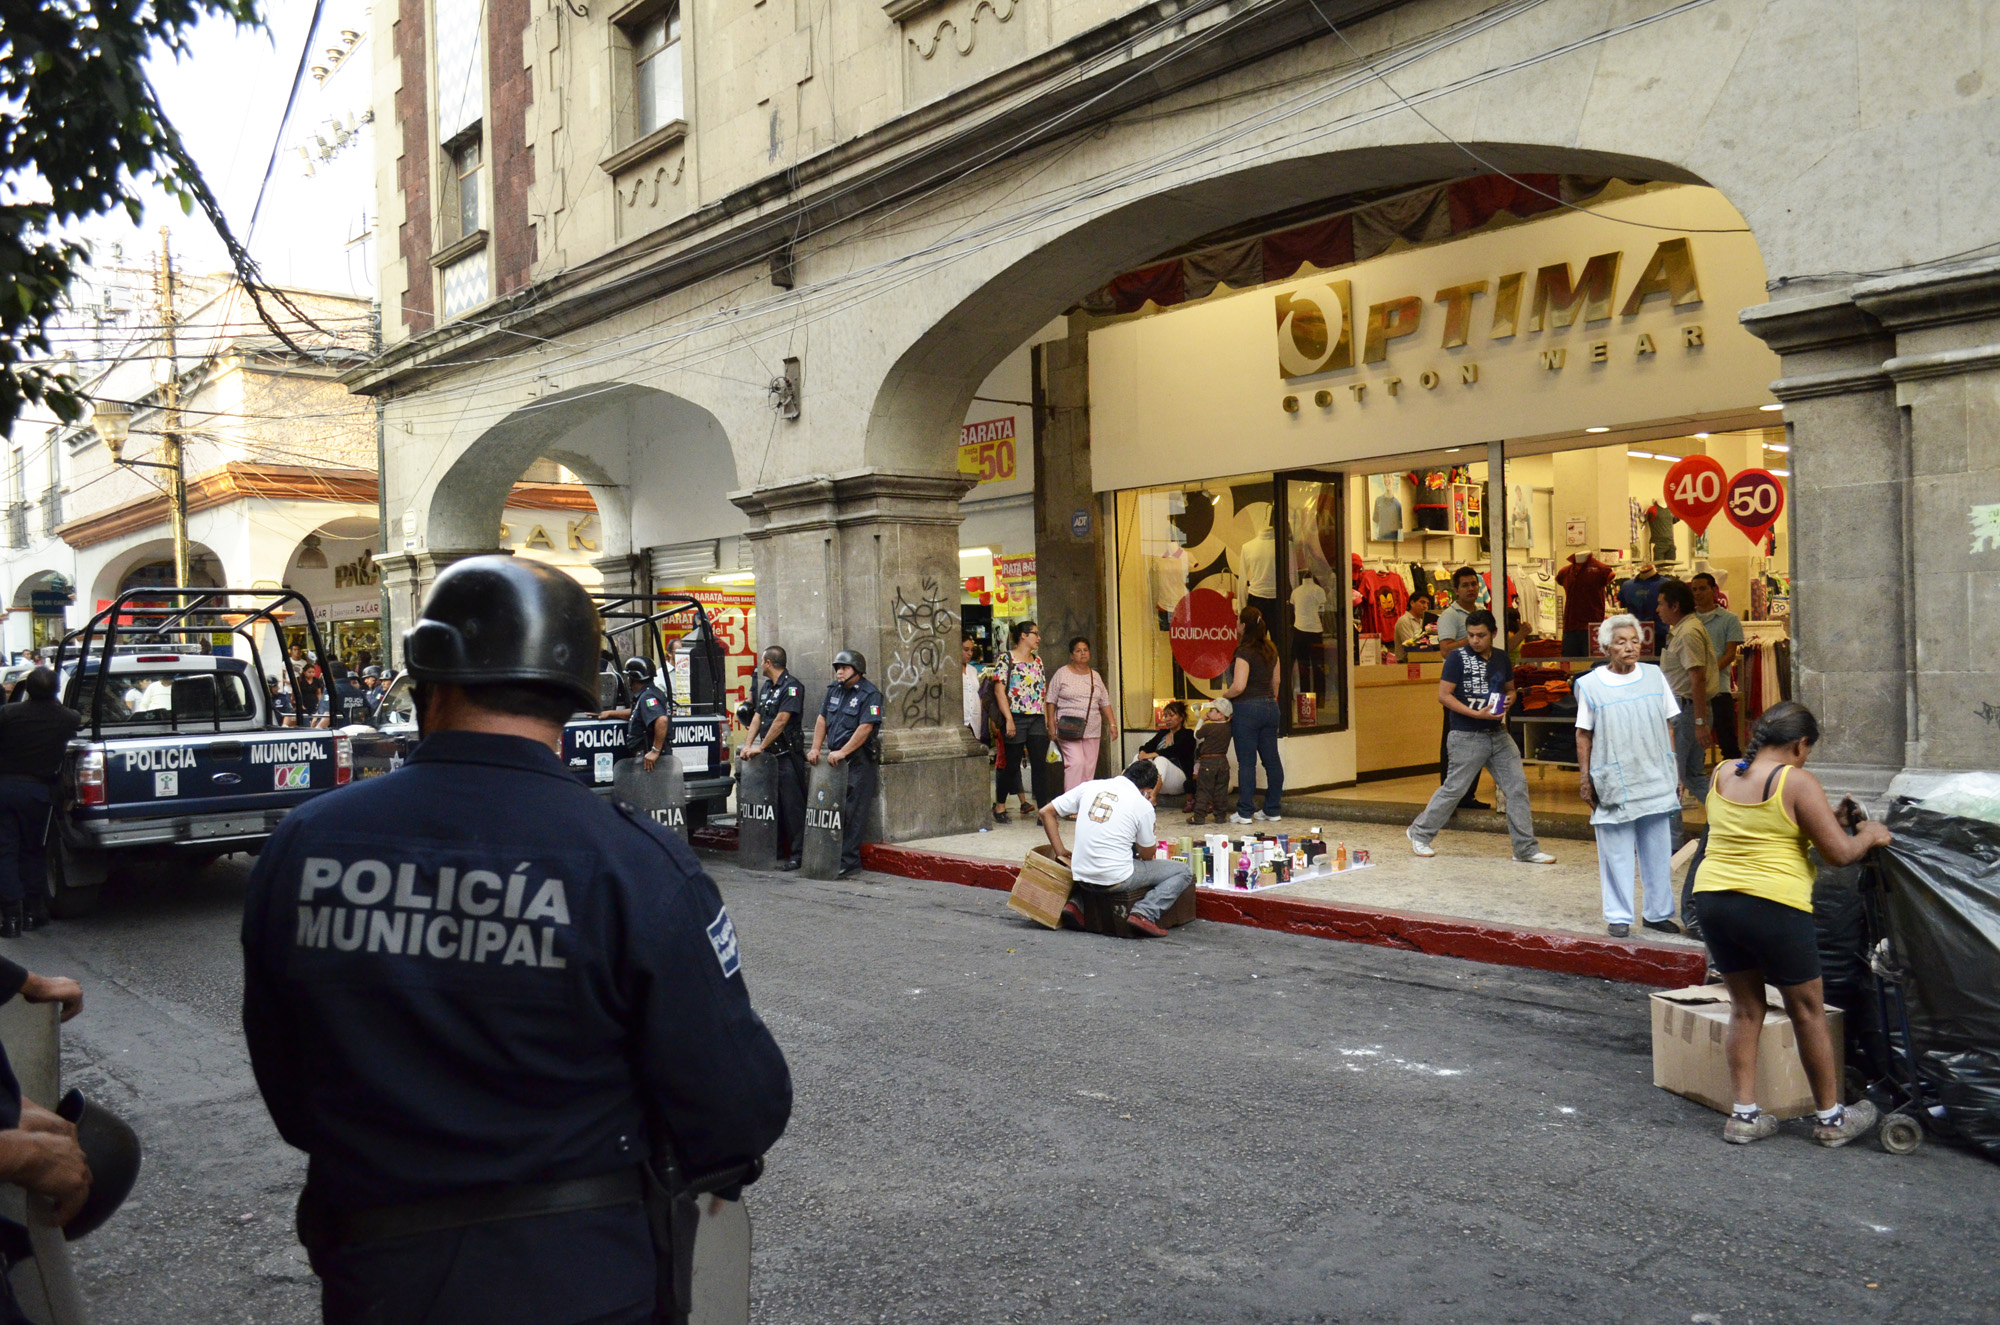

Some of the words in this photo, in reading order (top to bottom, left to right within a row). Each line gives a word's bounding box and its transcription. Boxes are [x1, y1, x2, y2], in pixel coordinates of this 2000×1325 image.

[1275, 237, 1703, 378] OPTIMA
[1282, 363, 1478, 413] COTTON
[1539, 325, 1703, 370] WEAR
[960, 420, 1013, 446] BARATA
[979, 441, 1014, 480] 50
[1669, 470, 1720, 505] $40
[1729, 484, 1777, 516] $50
[1074, 516, 1088, 527] ADT
[355, 602, 379, 614] PAKAR
[694, 592, 723, 603] BARATA
[1170, 625, 1238, 640] LIQUIDACIÓN
[1469, 655, 1480, 675] YORK
[1472, 676, 1481, 694] NEW
[1467, 697, 1487, 710] 77
[575, 725, 625, 749] POLICÍA
[125, 744, 197, 772] POLICÍA
[251, 741, 328, 764] MUNICIPAL
[275, 766, 310, 787] 066
[740, 803, 775, 820] POLICIA
[805, 808, 842, 830] POLICIA
[1088, 791, 1119, 824] 6
[299, 857, 571, 925] POLICÍA
[296, 905, 567, 969] MUNICIPAL
